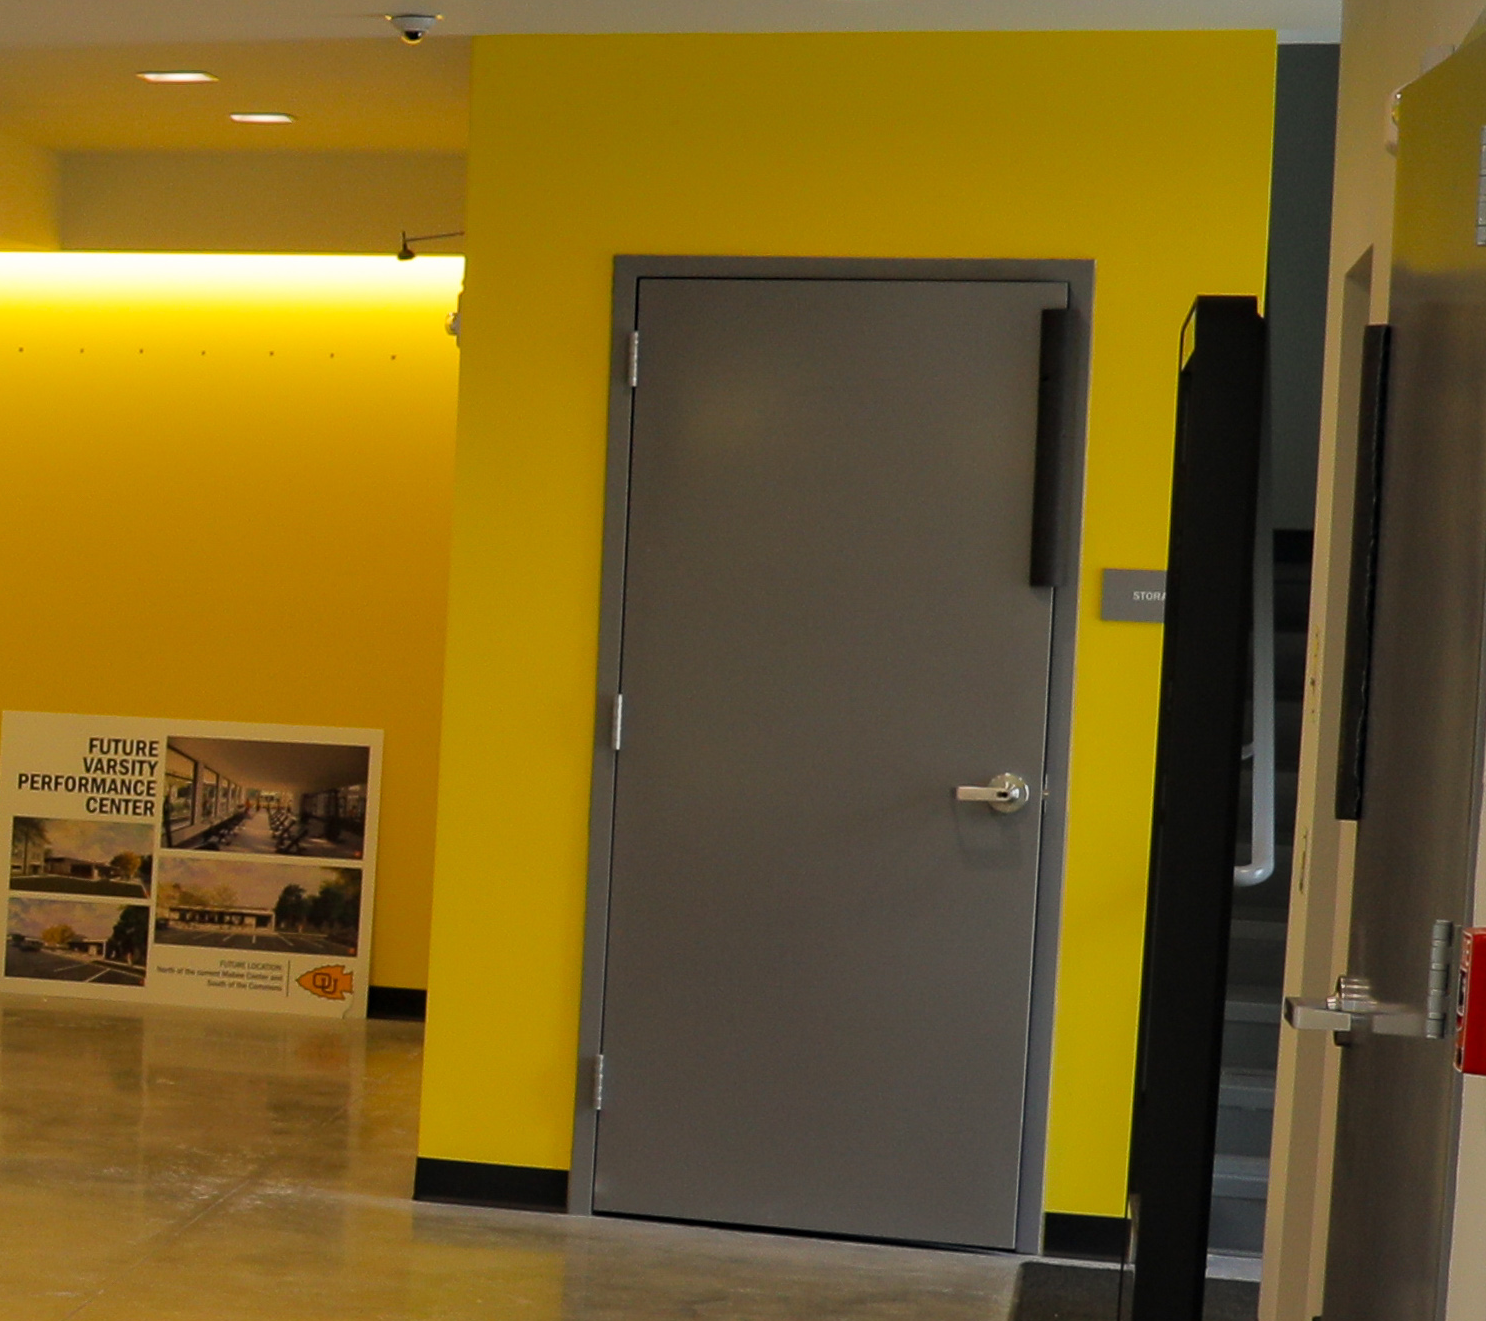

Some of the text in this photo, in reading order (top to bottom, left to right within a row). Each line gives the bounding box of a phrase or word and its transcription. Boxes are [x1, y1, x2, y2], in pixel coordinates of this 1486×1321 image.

[88, 737, 159, 758] FUTURE
[83, 757, 158, 777] VARSITY
[17, 773, 157, 797] PERFORMANCE
[85, 797, 155, 817] CENTER
